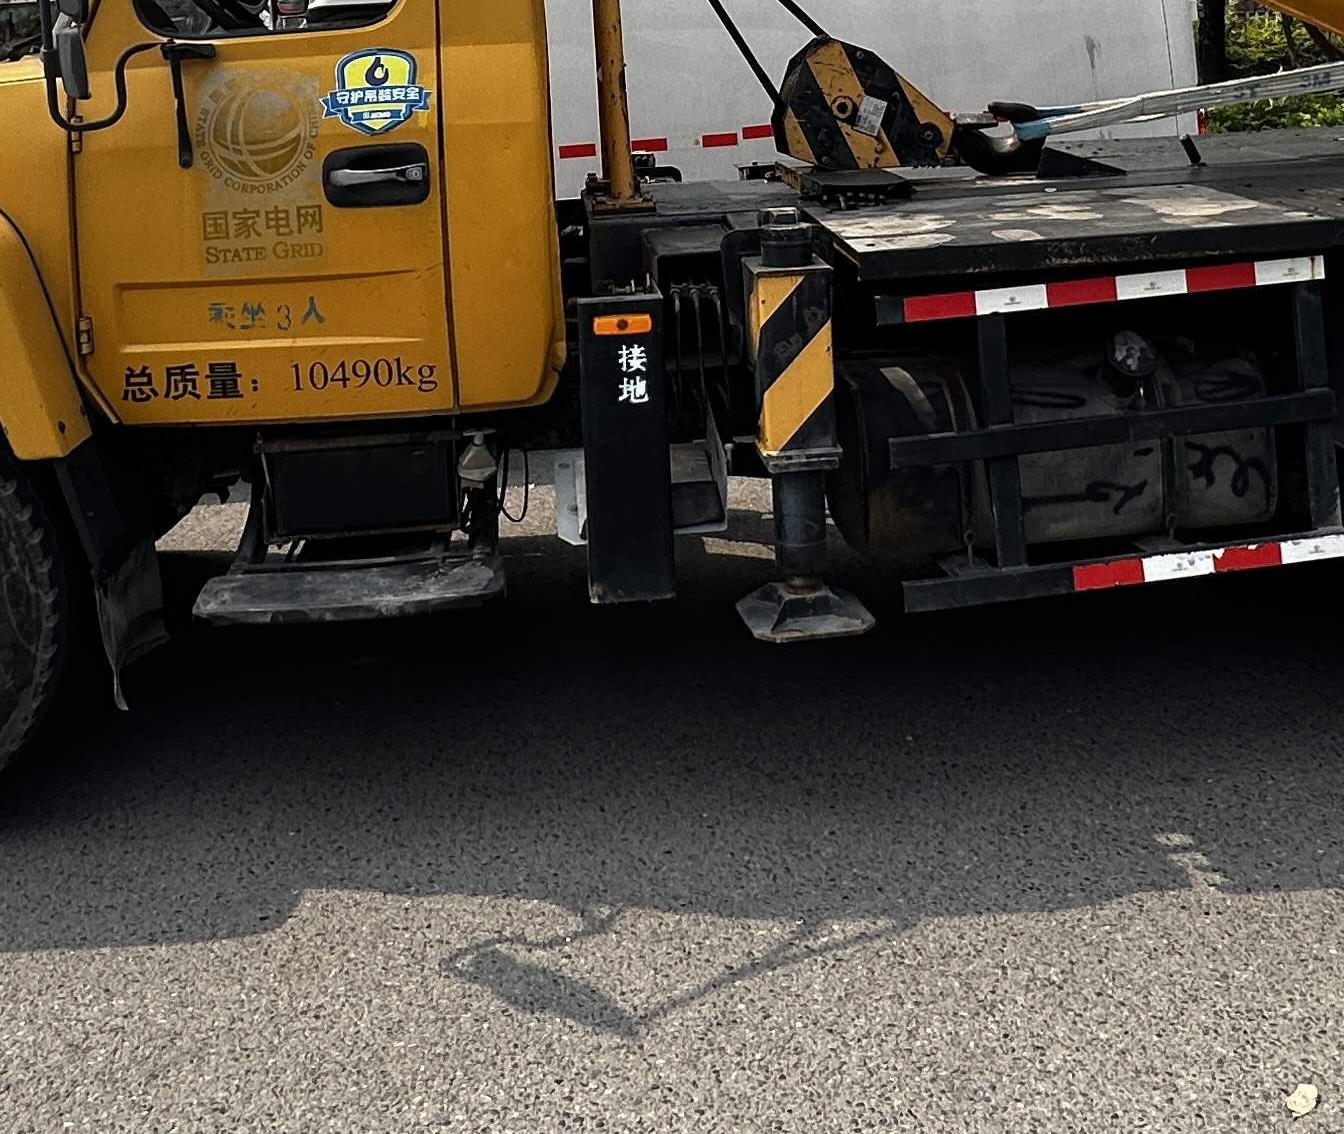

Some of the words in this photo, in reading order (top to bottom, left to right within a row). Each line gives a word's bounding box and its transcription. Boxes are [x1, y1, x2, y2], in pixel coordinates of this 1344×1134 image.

[336, 86, 420, 105] 守护吊装安全
[224, 163, 307, 194] CORPORATION
[201, 205, 324, 241] 国家电网
[205, 246, 267, 264] STATE
[272, 240, 324, 259] GRID
[291, 356, 439, 394] 10490kg
[618, 343, 650, 404] 接地
